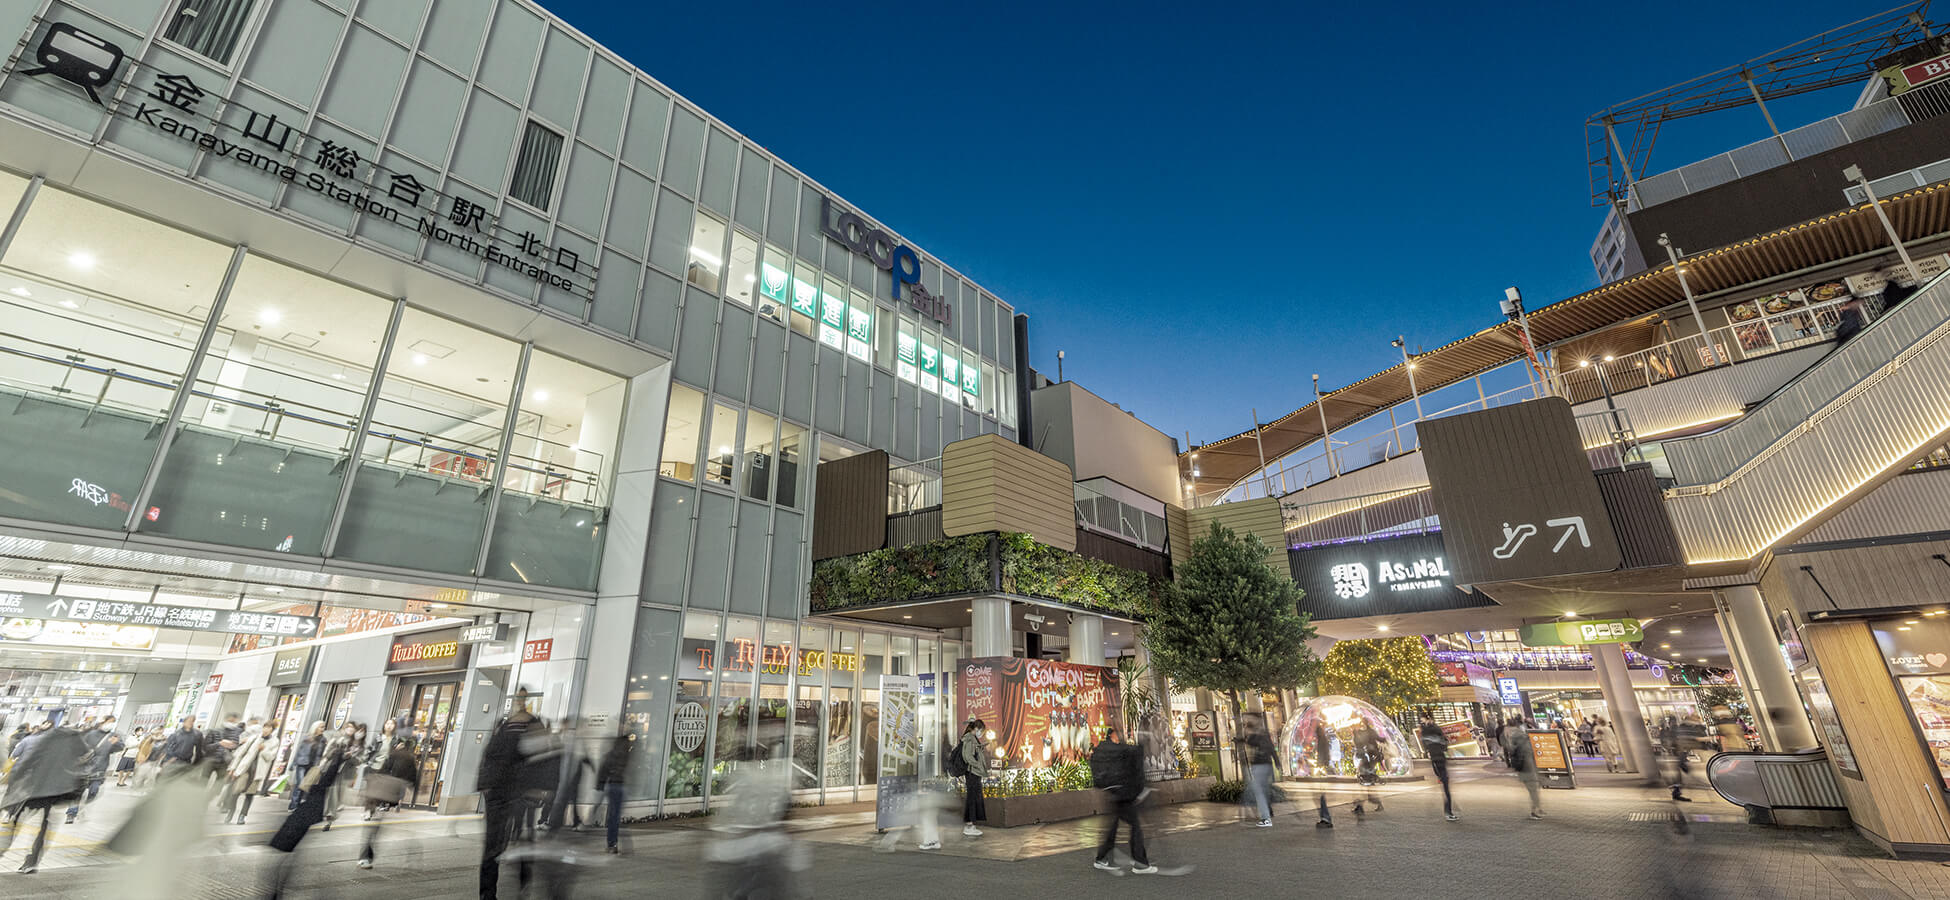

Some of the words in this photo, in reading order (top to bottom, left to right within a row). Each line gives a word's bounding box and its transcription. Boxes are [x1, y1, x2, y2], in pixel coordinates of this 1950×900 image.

[134, 102, 296, 182] Kanayama
[305, 173, 399, 224] Station
[417, 216, 481, 259] North
[486, 245, 574, 292] Entrance
[911, 282, 952, 328] 金山
[92, 612, 128, 624] Subway
[131, 616, 144, 625] JR
[145, 616, 164, 626] Line
[195, 621, 210, 629] Line
[228, 612, 261, 625] 地下鉄
[423, 641, 457, 659] COFFEE
[278, 657, 302, 671] BASE
[966, 664, 993, 678] COME
[977, 676, 992, 685] ON
[966, 686, 993, 697] LIGHT
[1024, 687, 1058, 709] LIGHT
[1077, 685, 1105, 710] PARTY
[966, 695, 993, 709] PARTY
